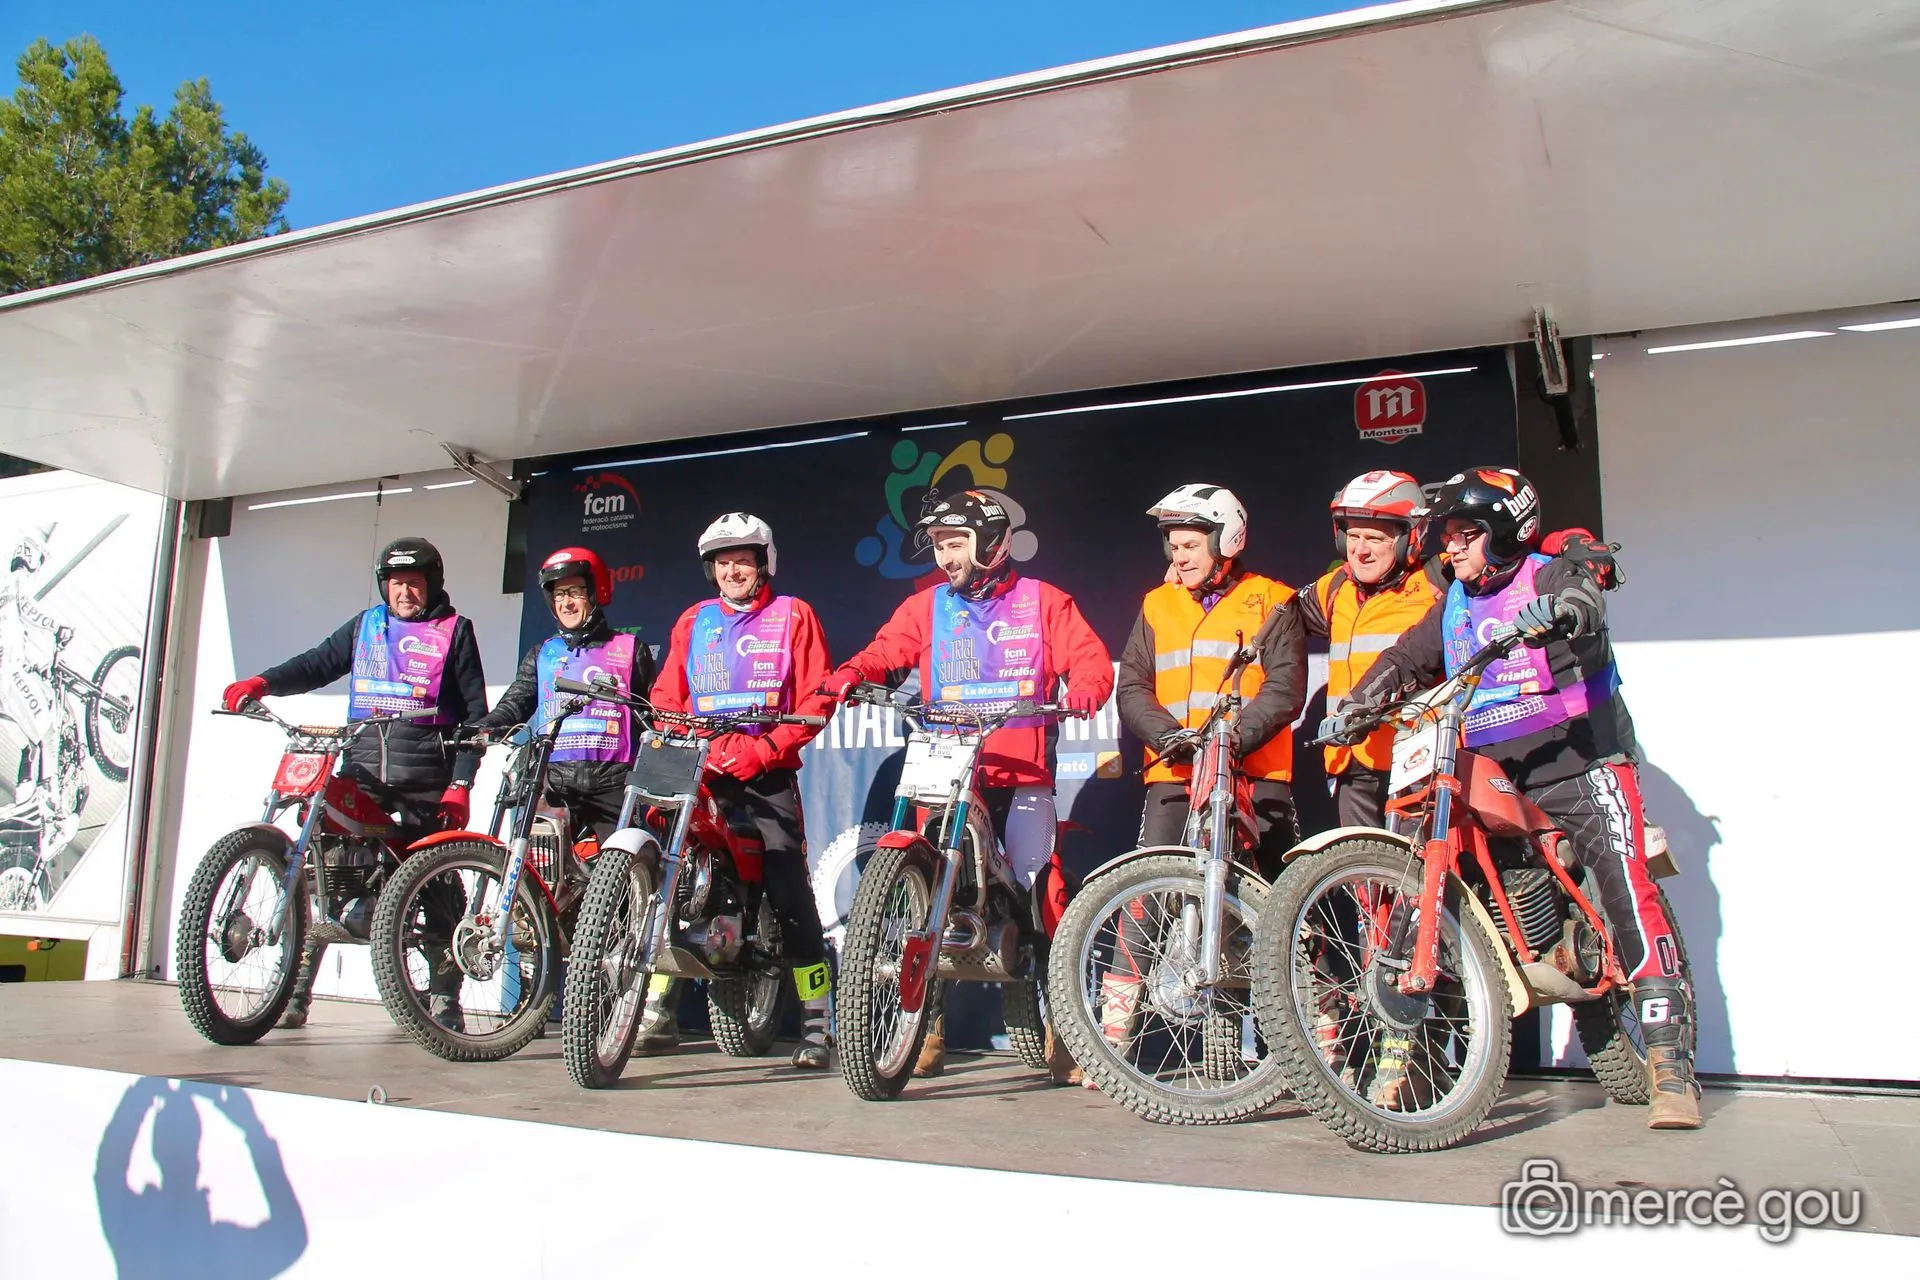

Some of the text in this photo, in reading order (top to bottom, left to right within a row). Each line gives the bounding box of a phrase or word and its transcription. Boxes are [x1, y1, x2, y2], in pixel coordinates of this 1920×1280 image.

[1363, 427, 1418, 438] Montesa
[584, 492, 625, 515] fcm
[583, 513, 635, 525] federació catalana
[590, 522, 628, 531] motociclisme
[1004, 648, 1027, 659] fcm
[407, 658, 427, 669] fcm
[753, 661, 774, 670] fcm
[999, 667, 1036, 678] TrialGo
[1496, 668, 1538, 682] TrialGo
[399, 673, 431, 685] TrialGo
[747, 679, 783, 688] TrialGo
[12, 671, 42, 719] REPSOL
[965, 687, 976, 695] La
[978, 685, 1014, 695] Marató
[716, 697, 724, 706] La
[726, 696, 761, 705] Marató
[590, 708, 622, 718] TrialGo
[801, 692, 905, 749] RIAL
[1057, 759, 1088, 772] rató
[1109, 759, 1119, 773] 3
[501, 856, 522, 912] Beta
